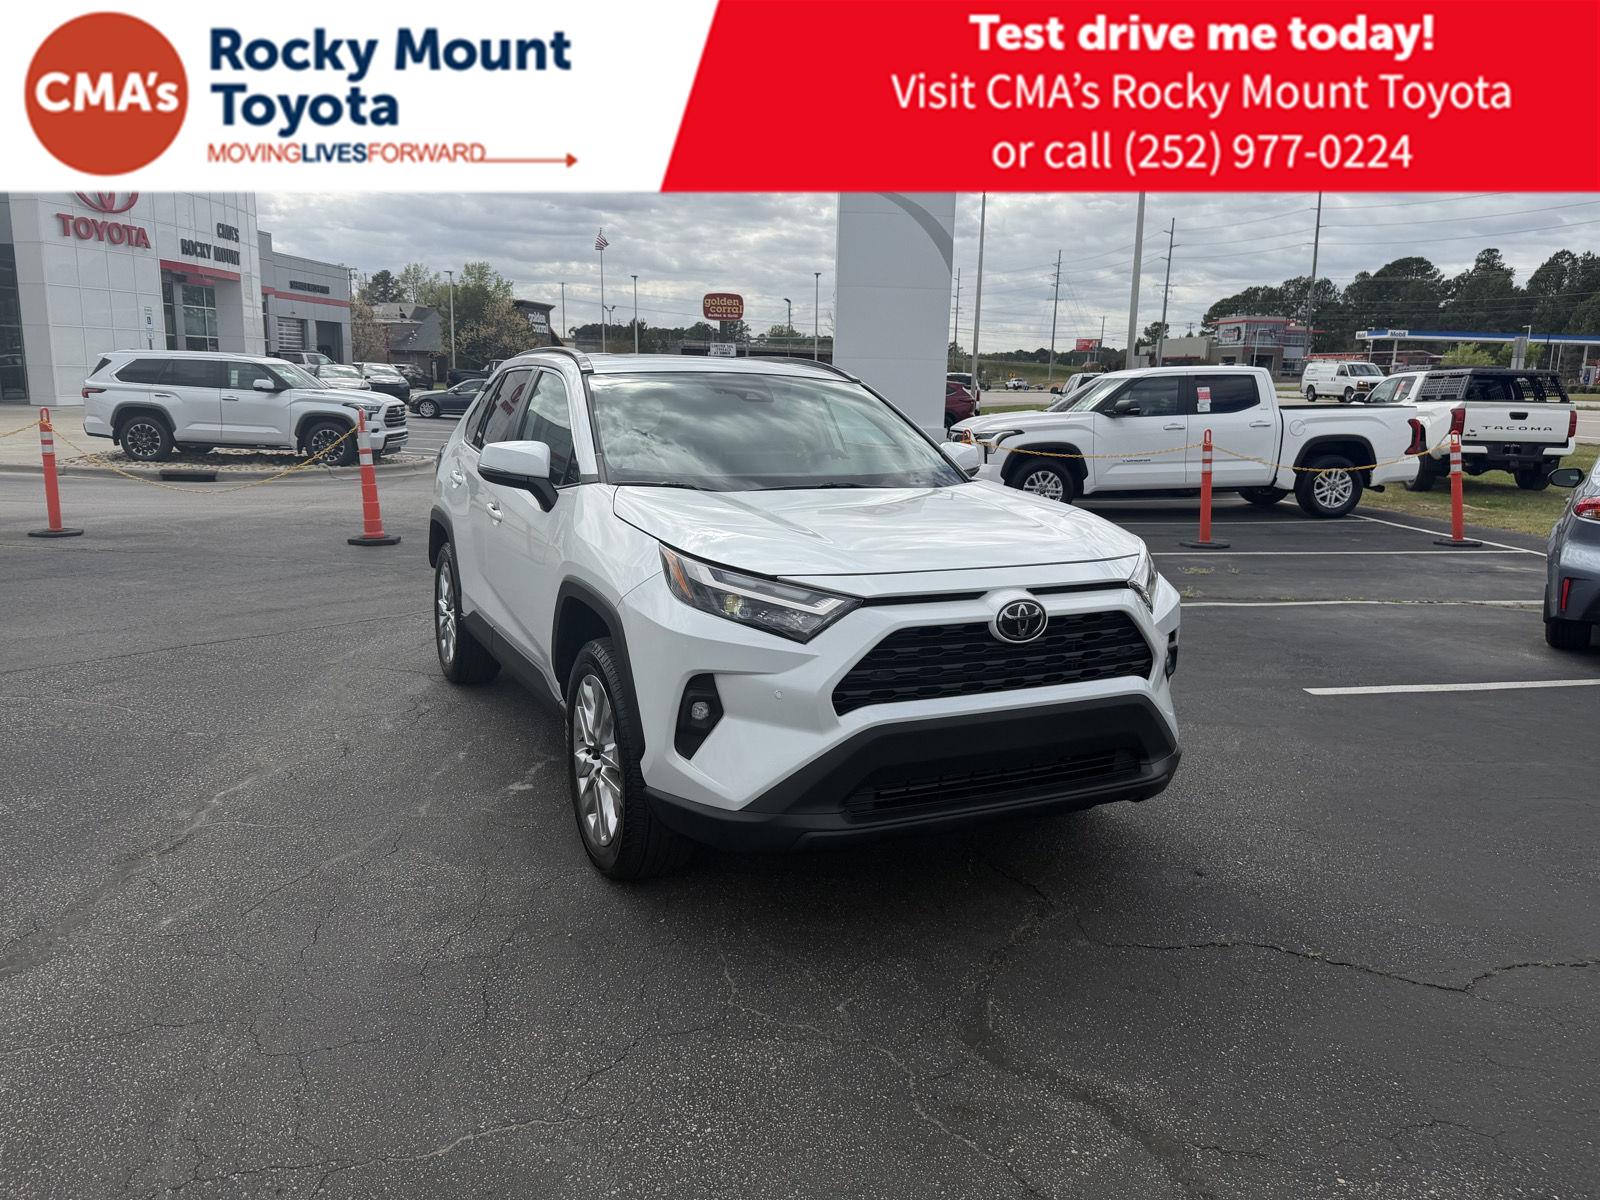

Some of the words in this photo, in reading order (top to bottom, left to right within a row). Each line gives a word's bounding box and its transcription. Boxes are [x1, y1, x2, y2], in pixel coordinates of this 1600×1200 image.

[56, 212, 151, 249] TOYOTA
[180, 238, 212, 260] ROCKY
[213, 245, 241, 266] MOUNT
[704, 297, 740, 307] golden
[710, 304, 743, 314] corral
